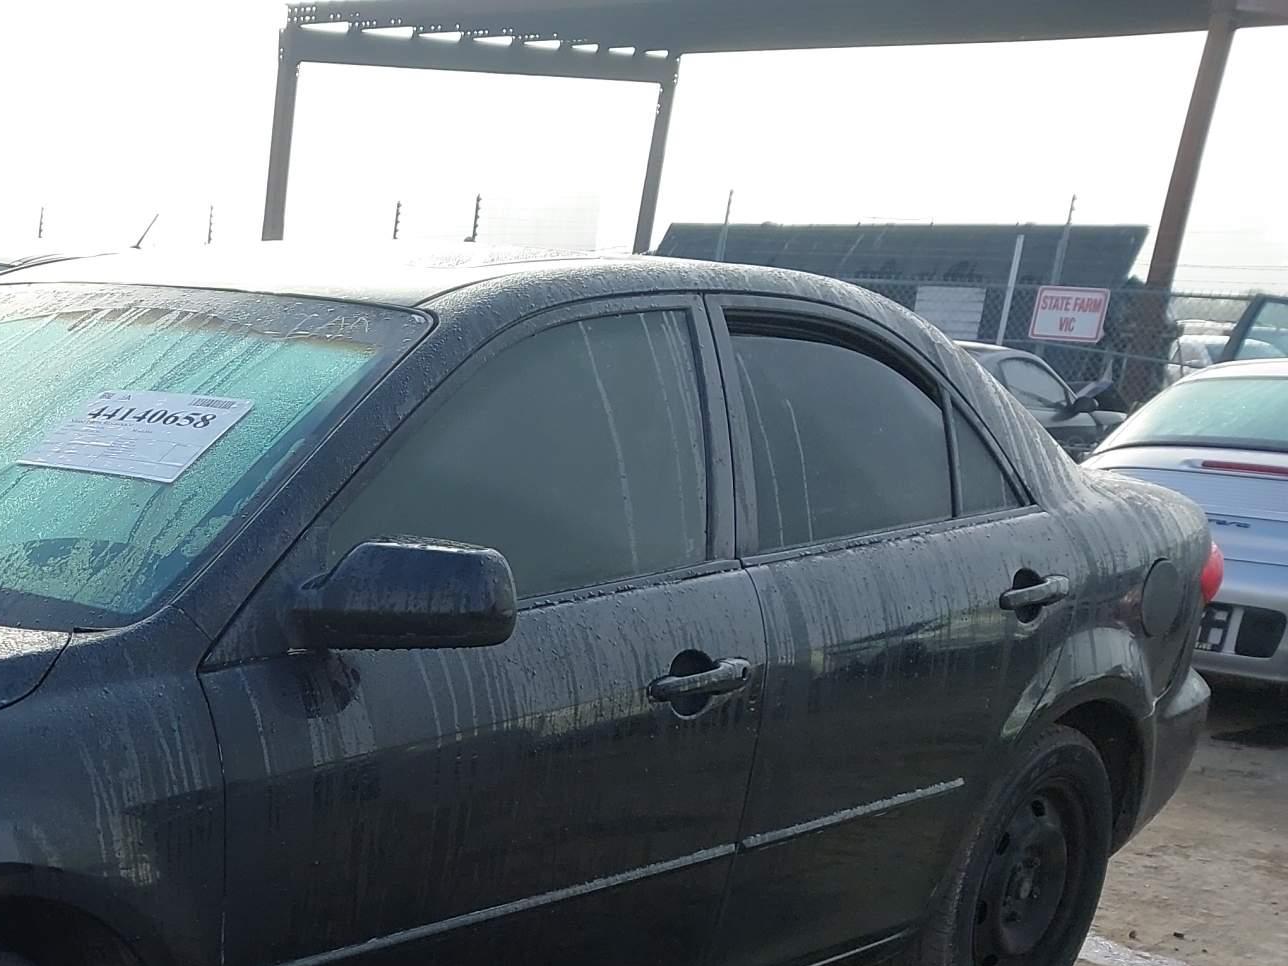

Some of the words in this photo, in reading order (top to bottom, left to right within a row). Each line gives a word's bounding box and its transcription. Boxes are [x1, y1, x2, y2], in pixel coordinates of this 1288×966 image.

[1040, 295, 1072, 312] STATE
[1073, 297, 1103, 313] FARM
[1059, 317, 1076, 333] VIC
[88, 405, 217, 429] 44140658
